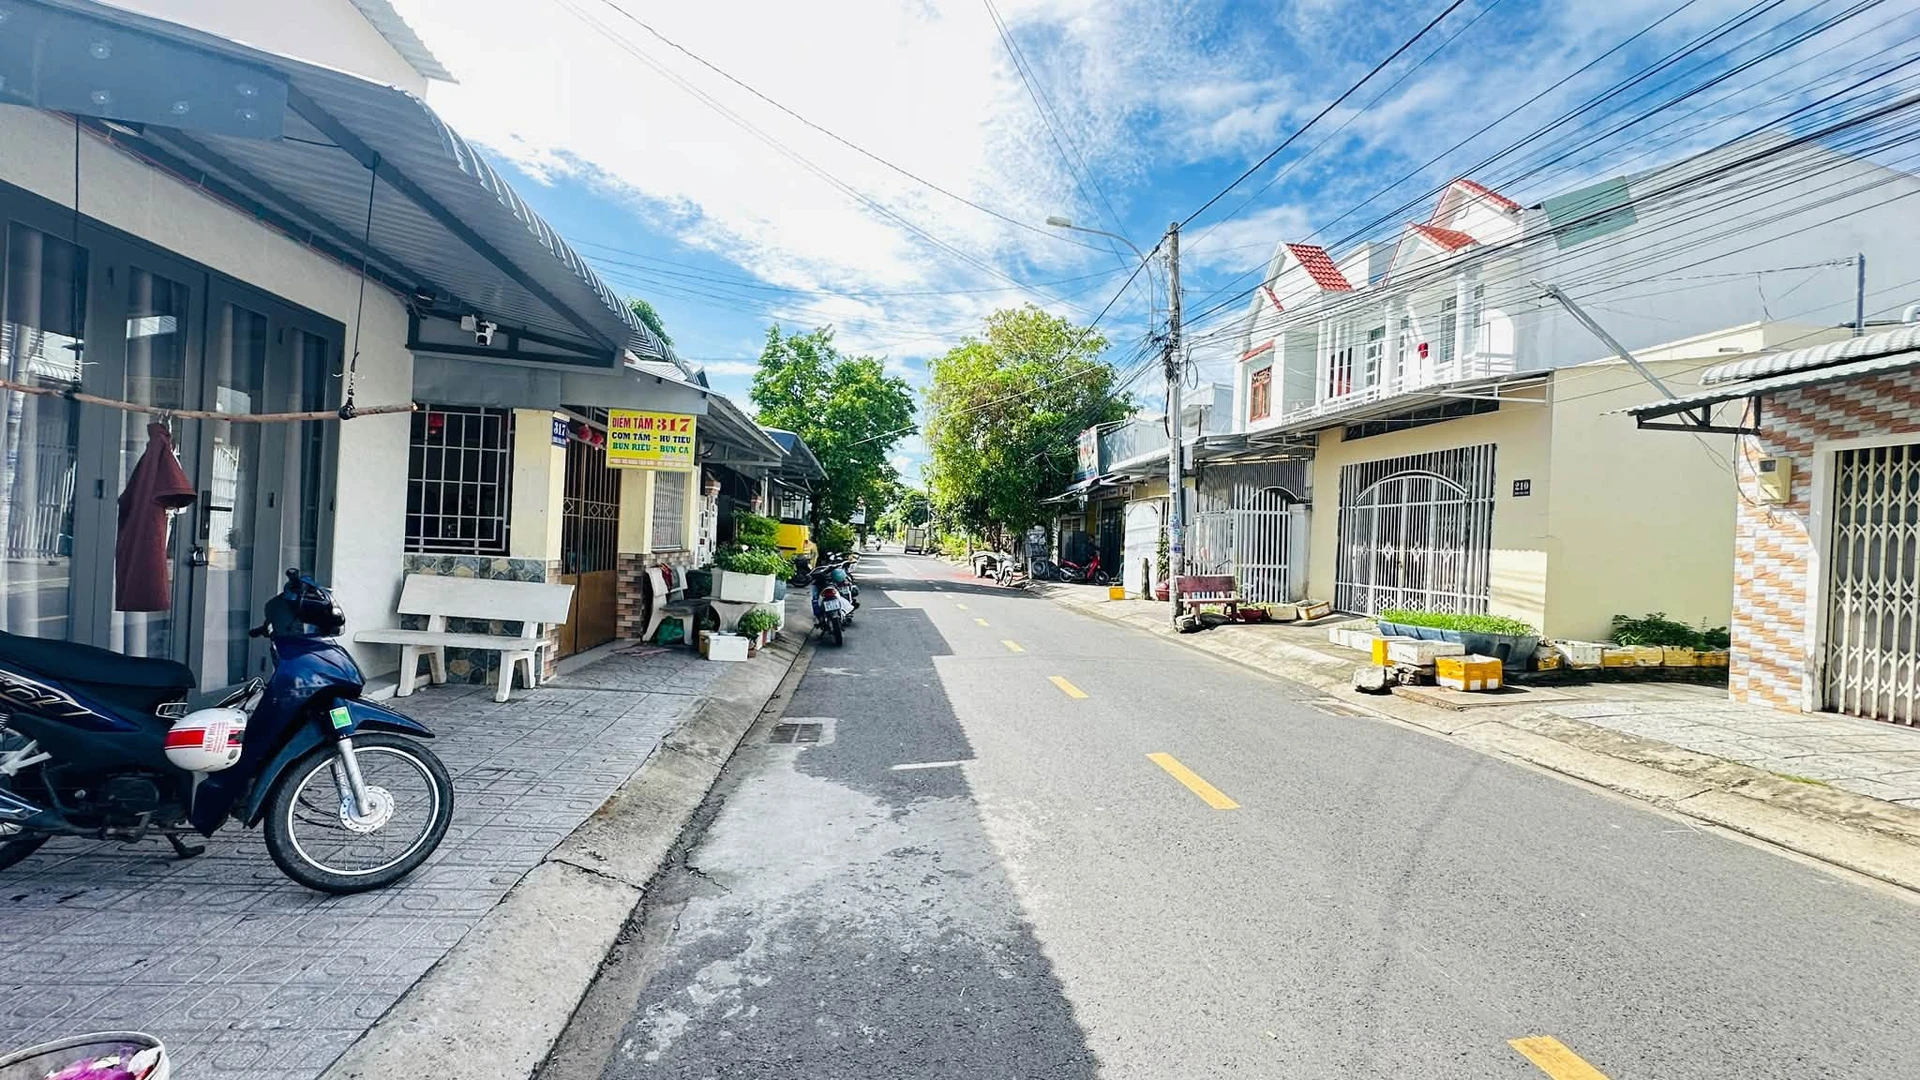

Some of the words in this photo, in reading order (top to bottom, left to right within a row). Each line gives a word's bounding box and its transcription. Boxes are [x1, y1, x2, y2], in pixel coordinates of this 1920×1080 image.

[553, 421, 567, 437] 317
[657, 418, 691, 432] 317
[1514, 481, 1529, 490] 210
